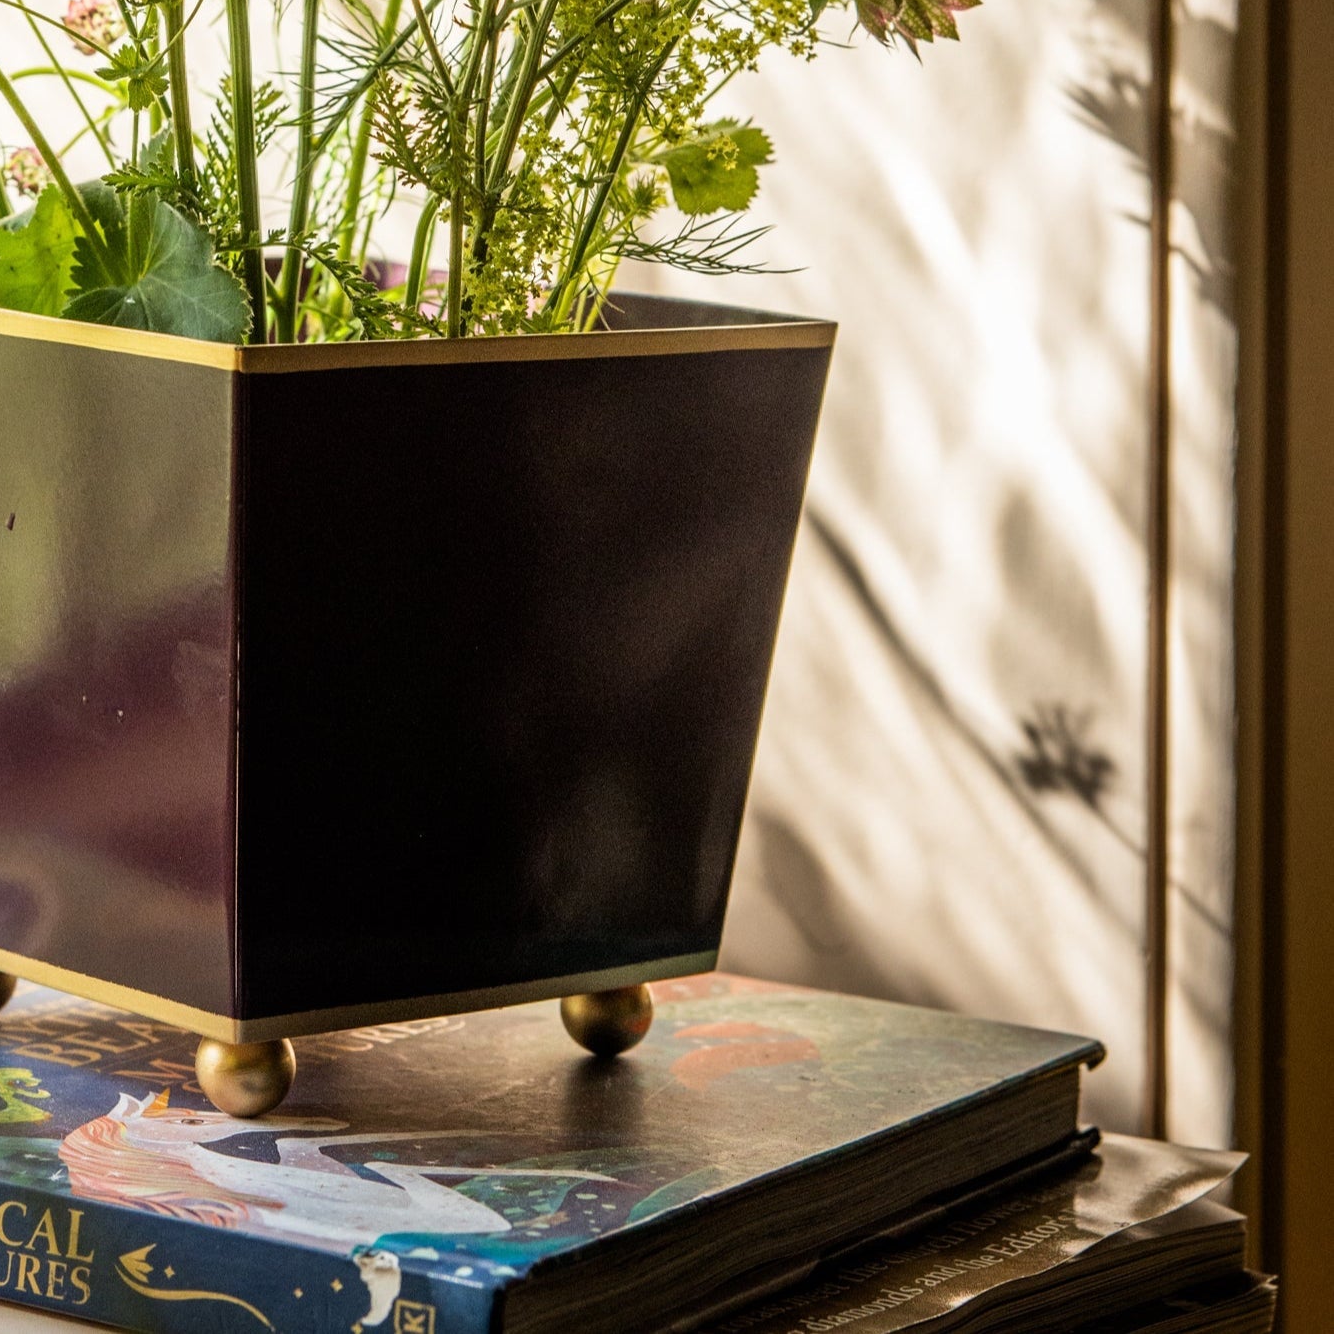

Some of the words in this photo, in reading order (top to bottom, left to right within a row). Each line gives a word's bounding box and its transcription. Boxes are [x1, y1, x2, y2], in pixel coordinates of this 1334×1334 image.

[800, 1276, 924, 1333] diamonds
[924, 1262, 966, 1289] and
[957, 1249, 1004, 1275] the
